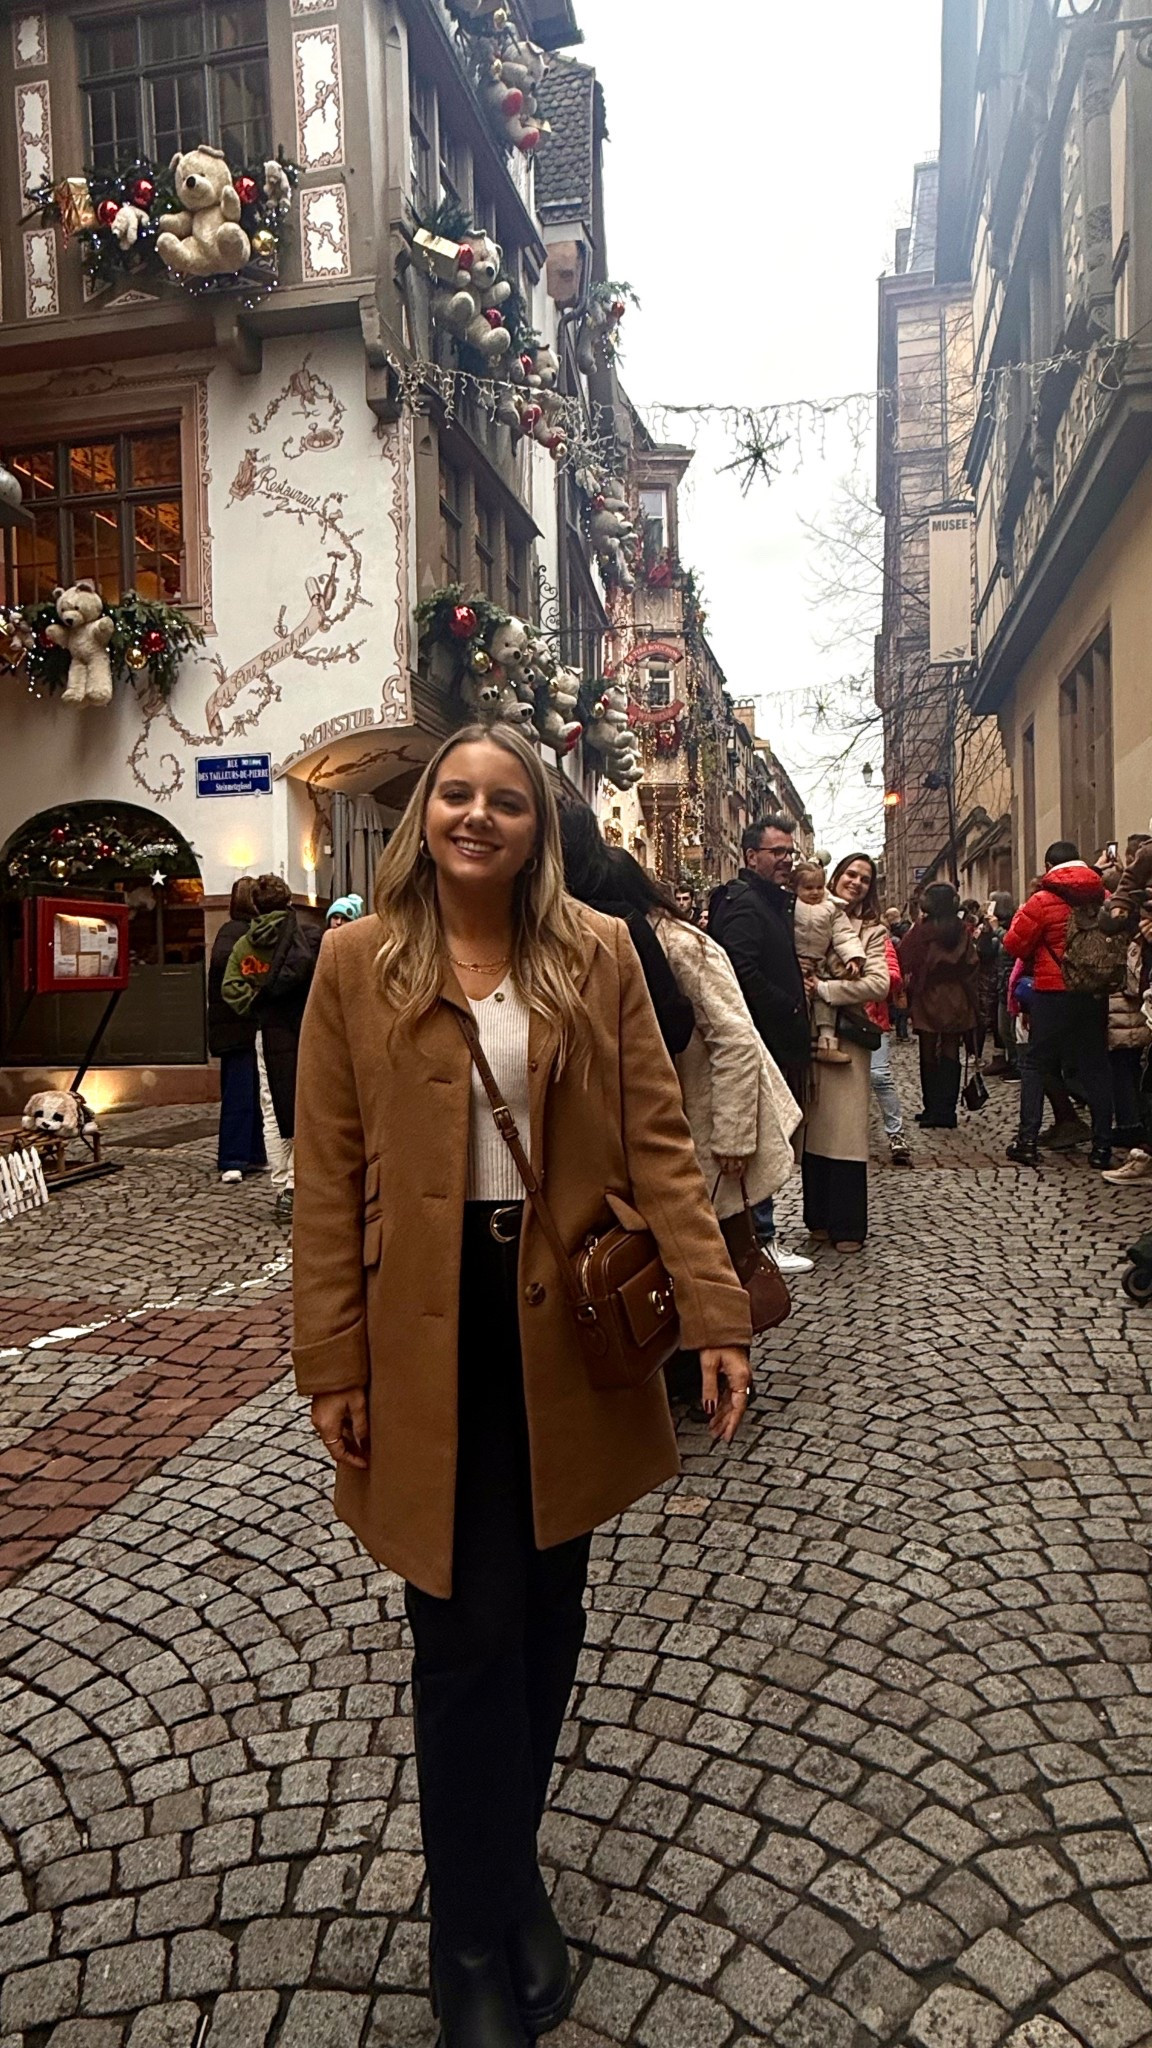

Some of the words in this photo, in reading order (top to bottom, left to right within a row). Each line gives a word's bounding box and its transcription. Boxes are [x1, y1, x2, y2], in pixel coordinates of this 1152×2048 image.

[254, 465, 321, 511] Restaurant
[932, 518, 969, 532] MUSEE
[260, 626, 312, 669] Bouchon
[300, 707, 374, 752] WINSTUB
[198, 772, 209, 781] DES
